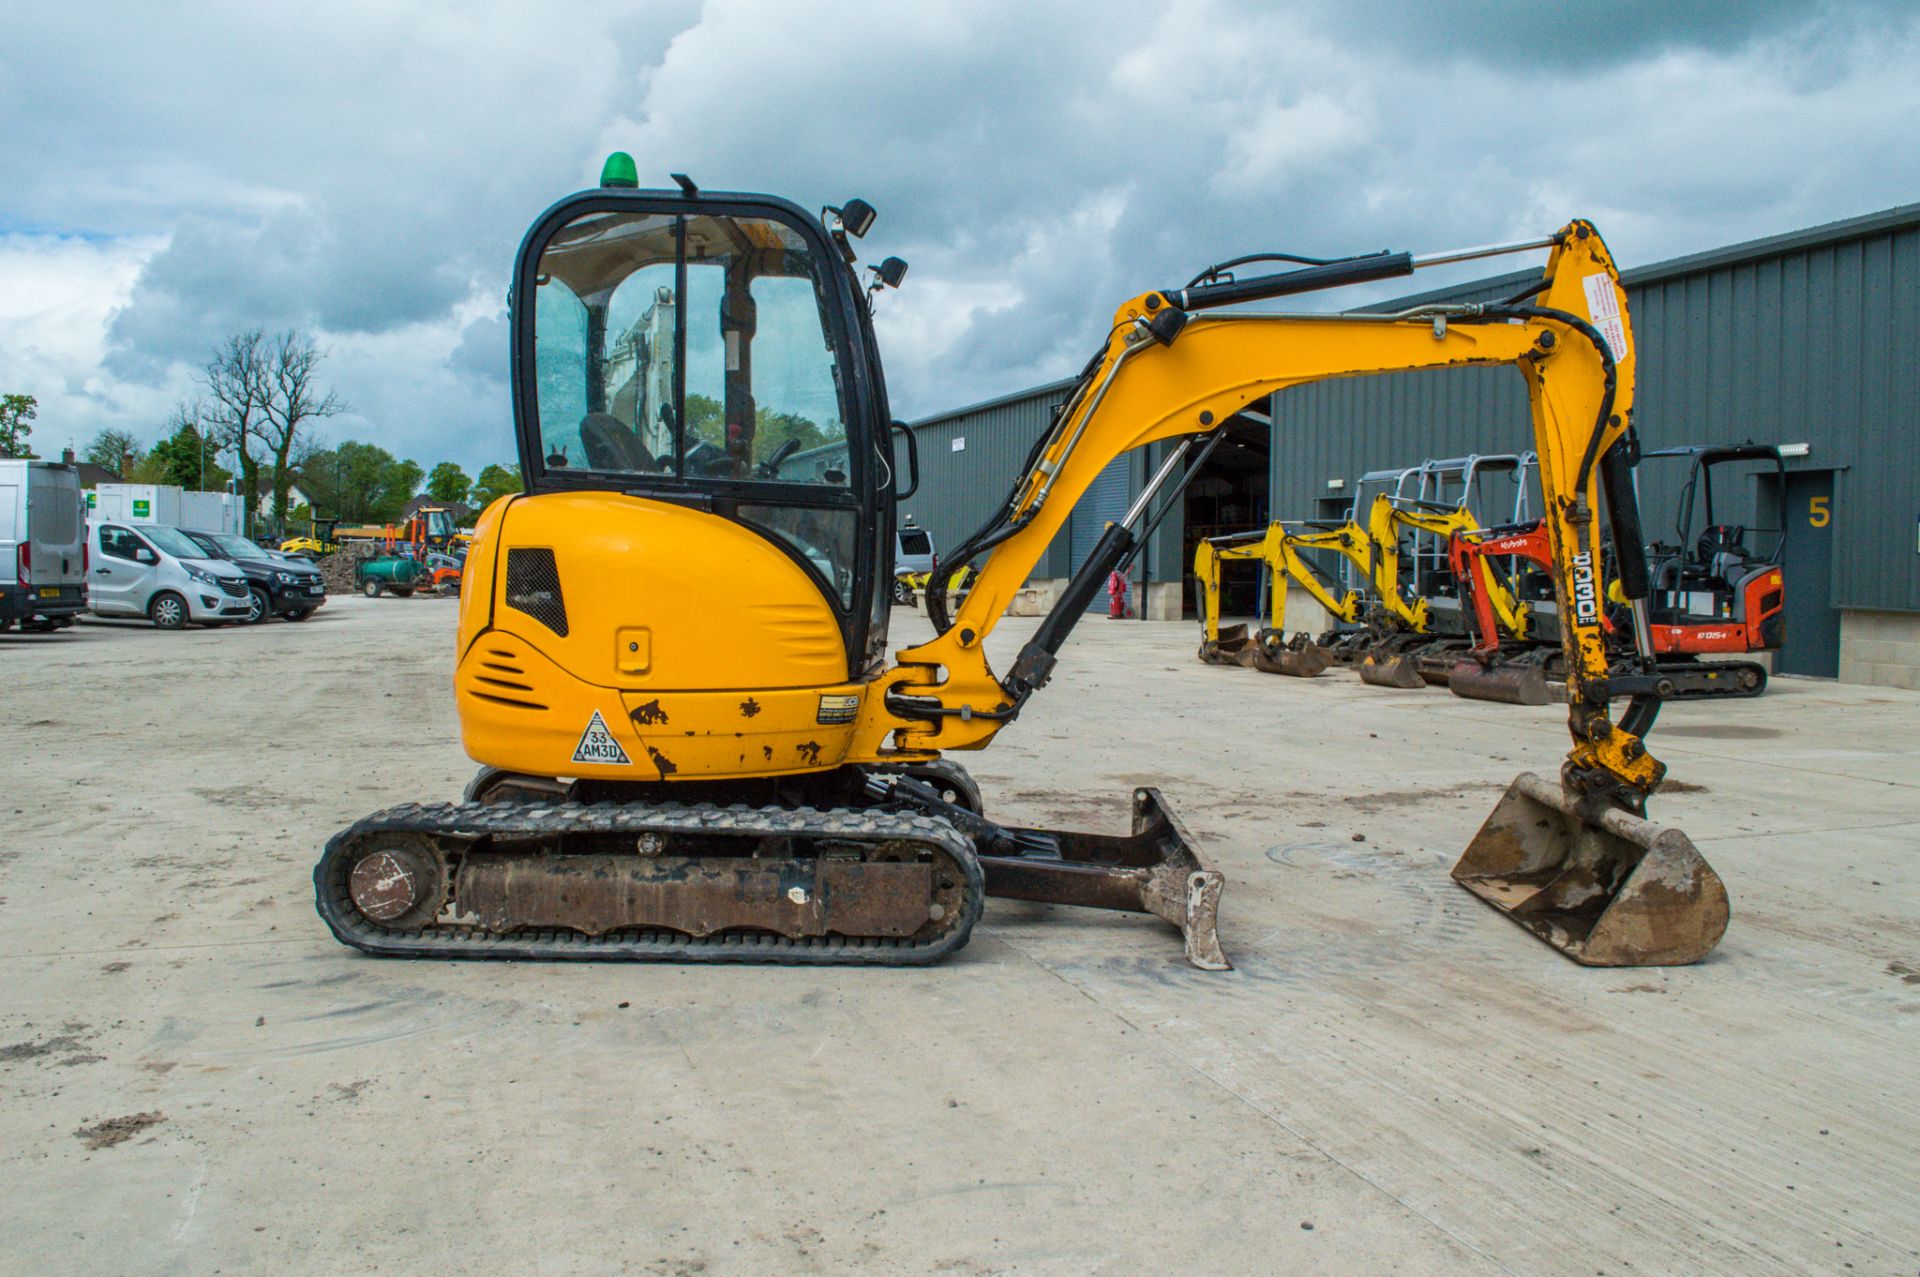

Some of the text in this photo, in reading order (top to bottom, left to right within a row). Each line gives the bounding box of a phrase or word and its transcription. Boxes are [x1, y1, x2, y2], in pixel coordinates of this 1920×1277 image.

[1809, 496, 1830, 528] 5
[1501, 539, 1528, 550] Kubota
[590, 731, 607, 744] 33
[583, 744, 618, 758] AM3D
